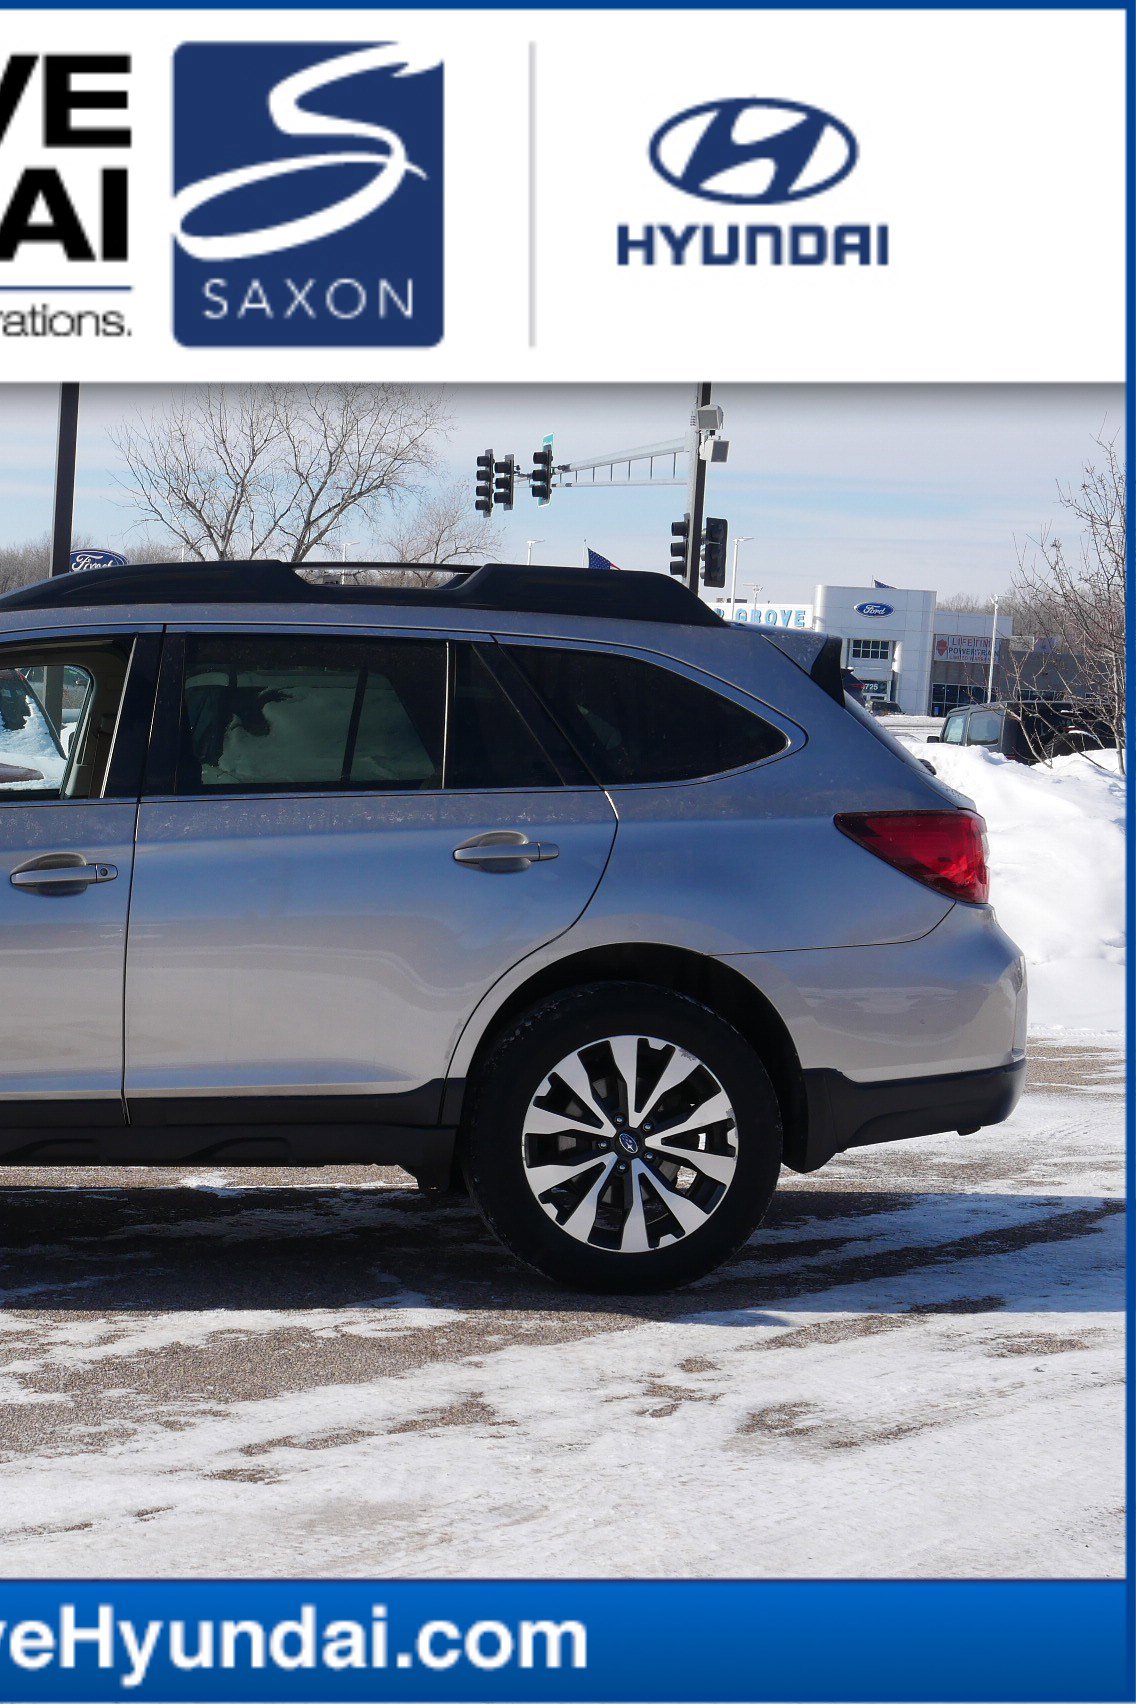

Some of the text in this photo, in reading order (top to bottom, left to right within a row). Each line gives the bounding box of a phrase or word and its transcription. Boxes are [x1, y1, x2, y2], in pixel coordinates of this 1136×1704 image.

[863, 604, 885, 615] Ford
[734, 607, 806, 627] GROVE
[952, 637, 996, 648] LIFETIM
[948, 646, 1000, 657] POWERTRAN
